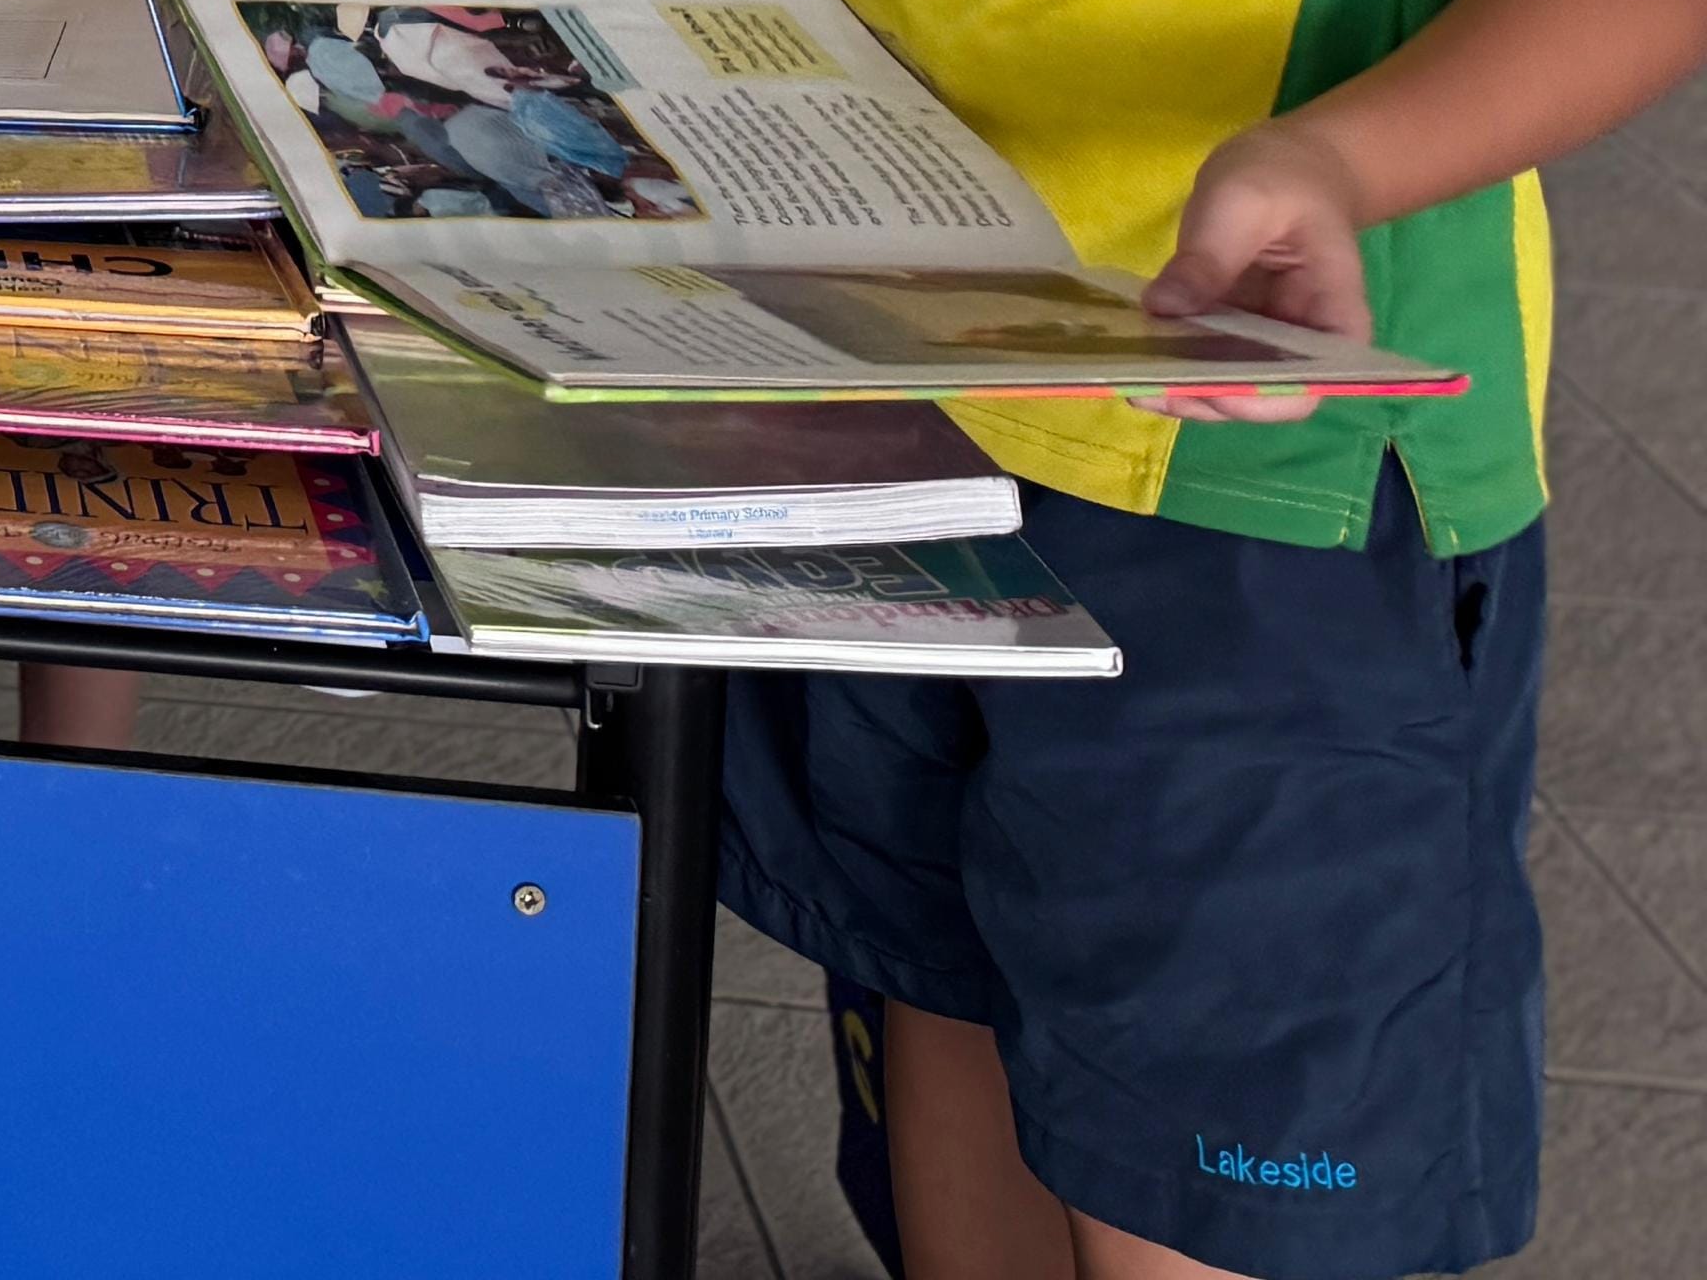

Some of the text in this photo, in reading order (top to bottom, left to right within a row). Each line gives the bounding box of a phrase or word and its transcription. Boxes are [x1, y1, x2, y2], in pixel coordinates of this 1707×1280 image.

[689, 507, 741, 523] Primary
[743, 505, 788, 520] School
[1196, 1134, 1358, 1190] Lakeside
